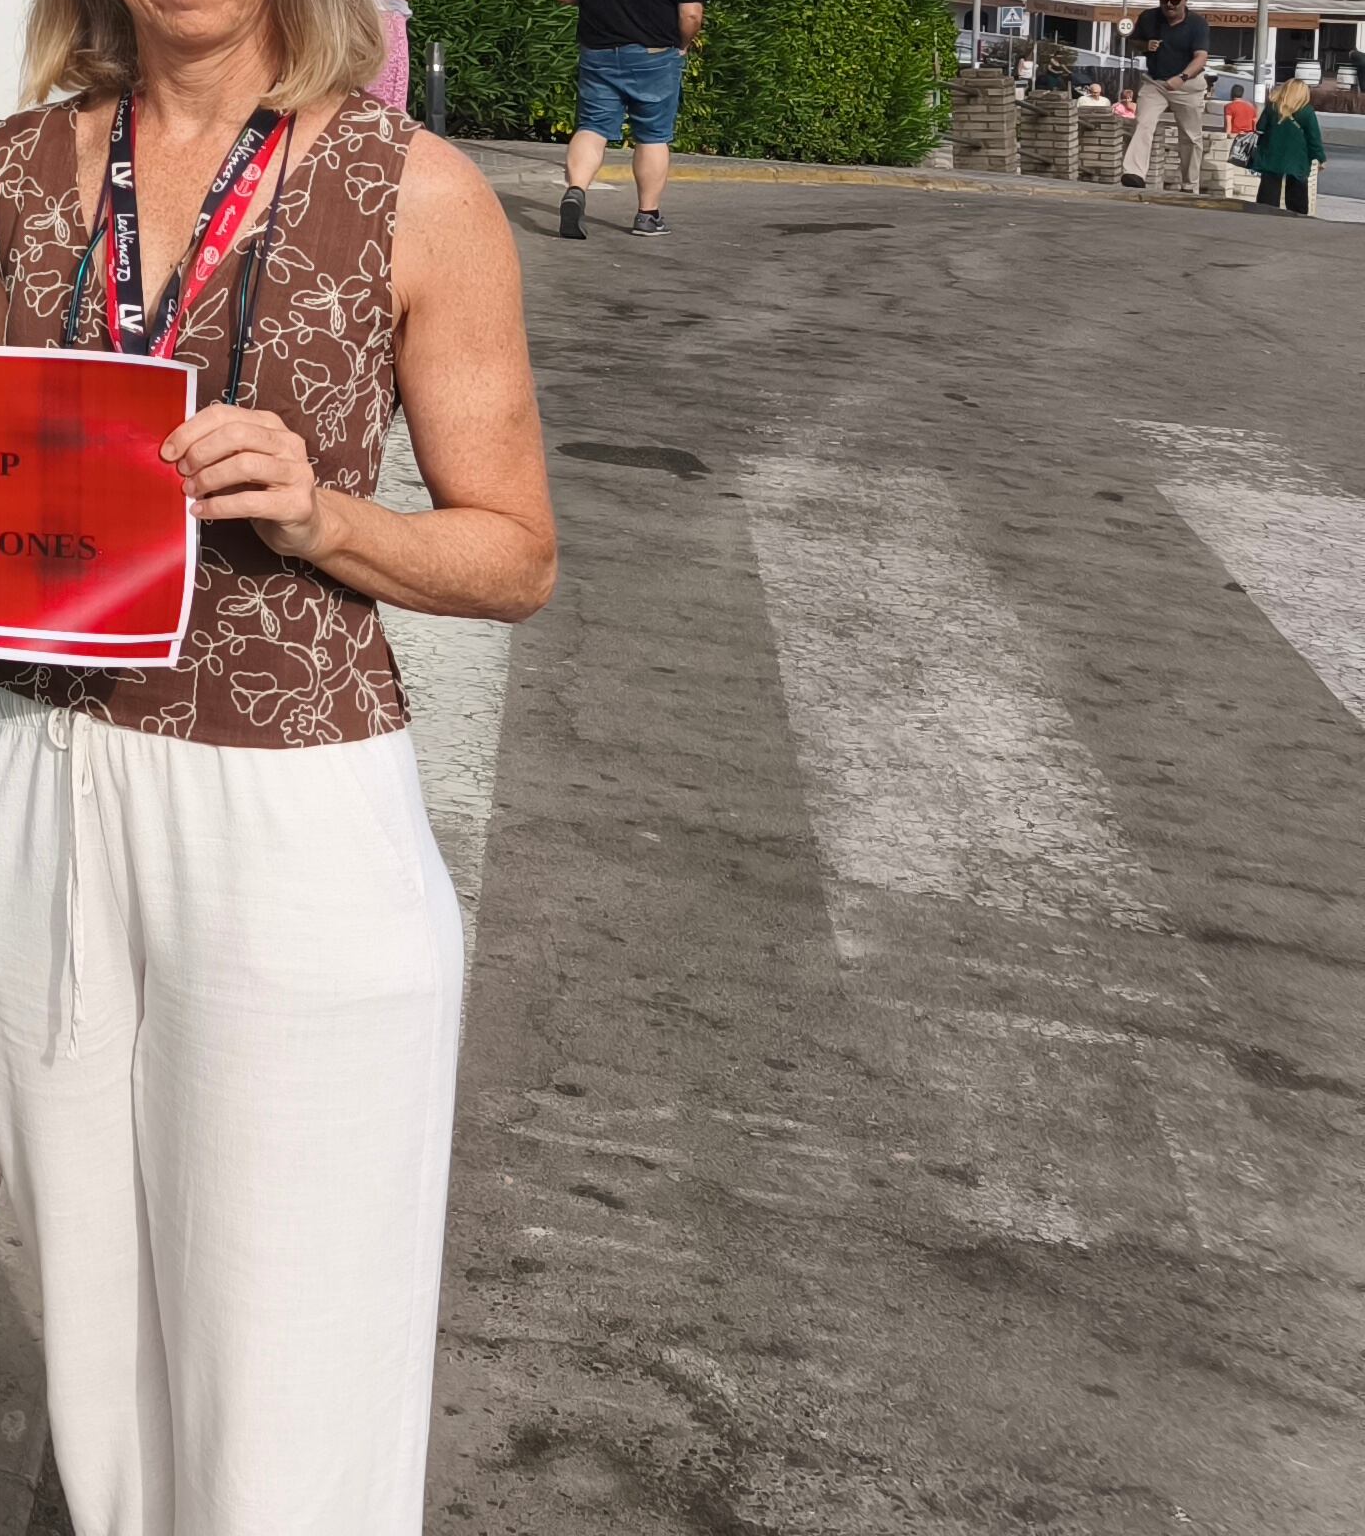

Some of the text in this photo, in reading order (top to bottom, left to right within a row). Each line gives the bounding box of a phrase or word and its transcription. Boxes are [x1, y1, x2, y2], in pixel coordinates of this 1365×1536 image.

[1120, 21, 1131, 30] 20
[111, 162, 134, 190] LV
[118, 304, 143, 334] LV
